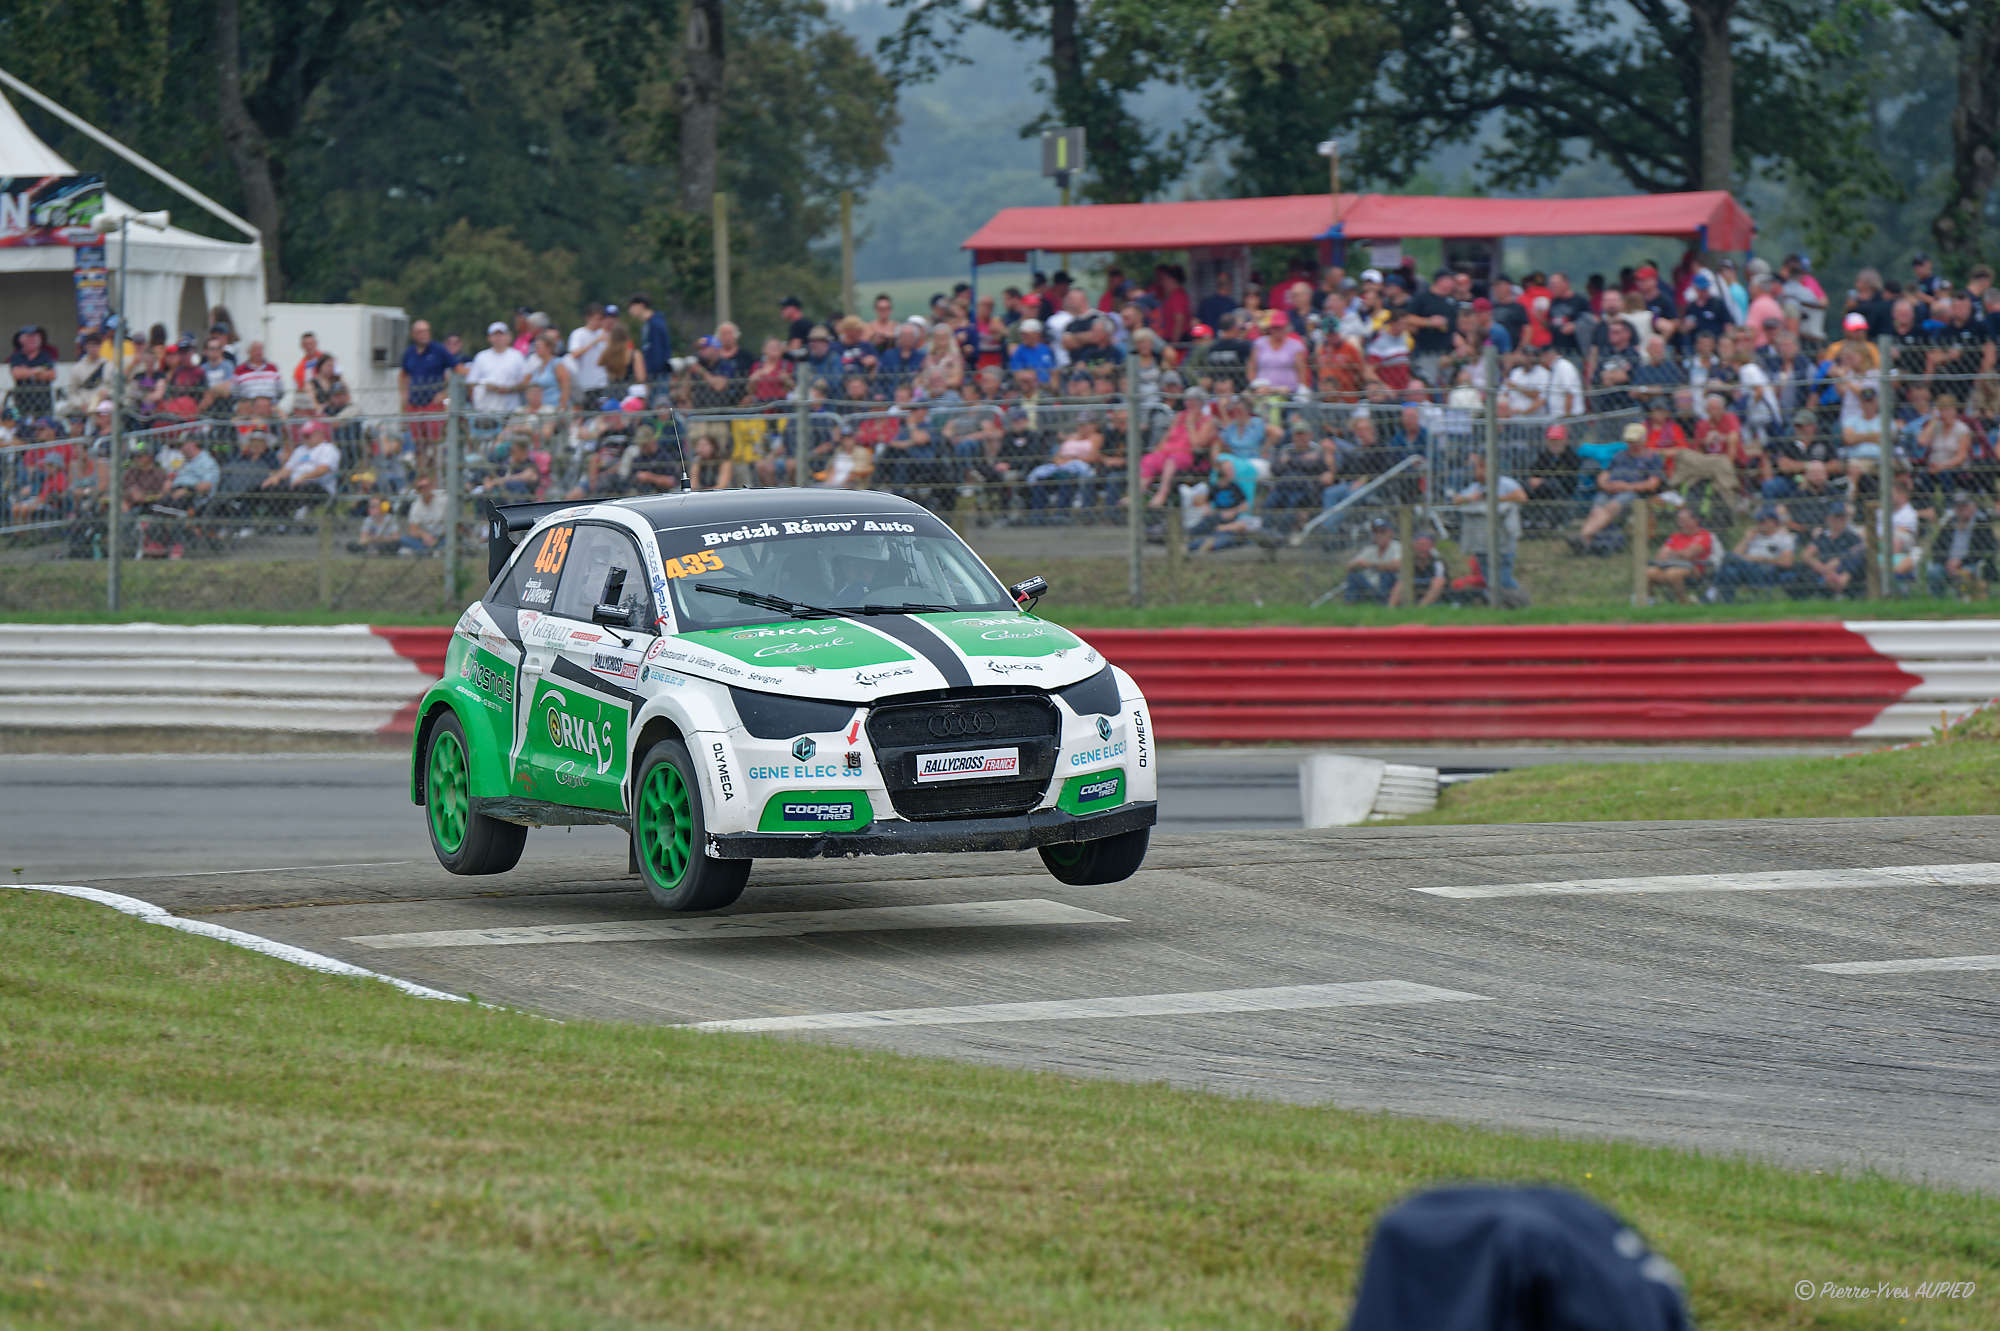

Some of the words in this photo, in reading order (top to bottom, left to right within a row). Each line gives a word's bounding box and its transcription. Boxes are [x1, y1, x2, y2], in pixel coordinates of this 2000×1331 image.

[701, 523, 779, 546] Breizh
[782, 519, 858, 535] Rénov'
[863, 520, 915, 533] Auto
[534, 527, 573, 574] 435
[666, 550, 725, 579] 435
[594, 652, 623, 673] RALLYCROSS
[995, 663, 1044, 671] LUCAS
[864, 668, 913, 681] LUCAS
[1134, 710, 1147, 768] OLYMECA
[924, 756, 984, 773] RALLYCROSS
[984, 758, 1016, 771] FRANCE
[1071, 749, 1101, 766] GENE
[713, 743, 733, 801] OLYMECA
[750, 767, 790, 780] GENE
[794, 766, 837, 778] ELEC
[1080, 778, 1119, 795] COOPER
[1098, 788, 1117, 798] TIRES
[784, 804, 852, 814] COOPER
[817, 812, 851, 820] TIRES
